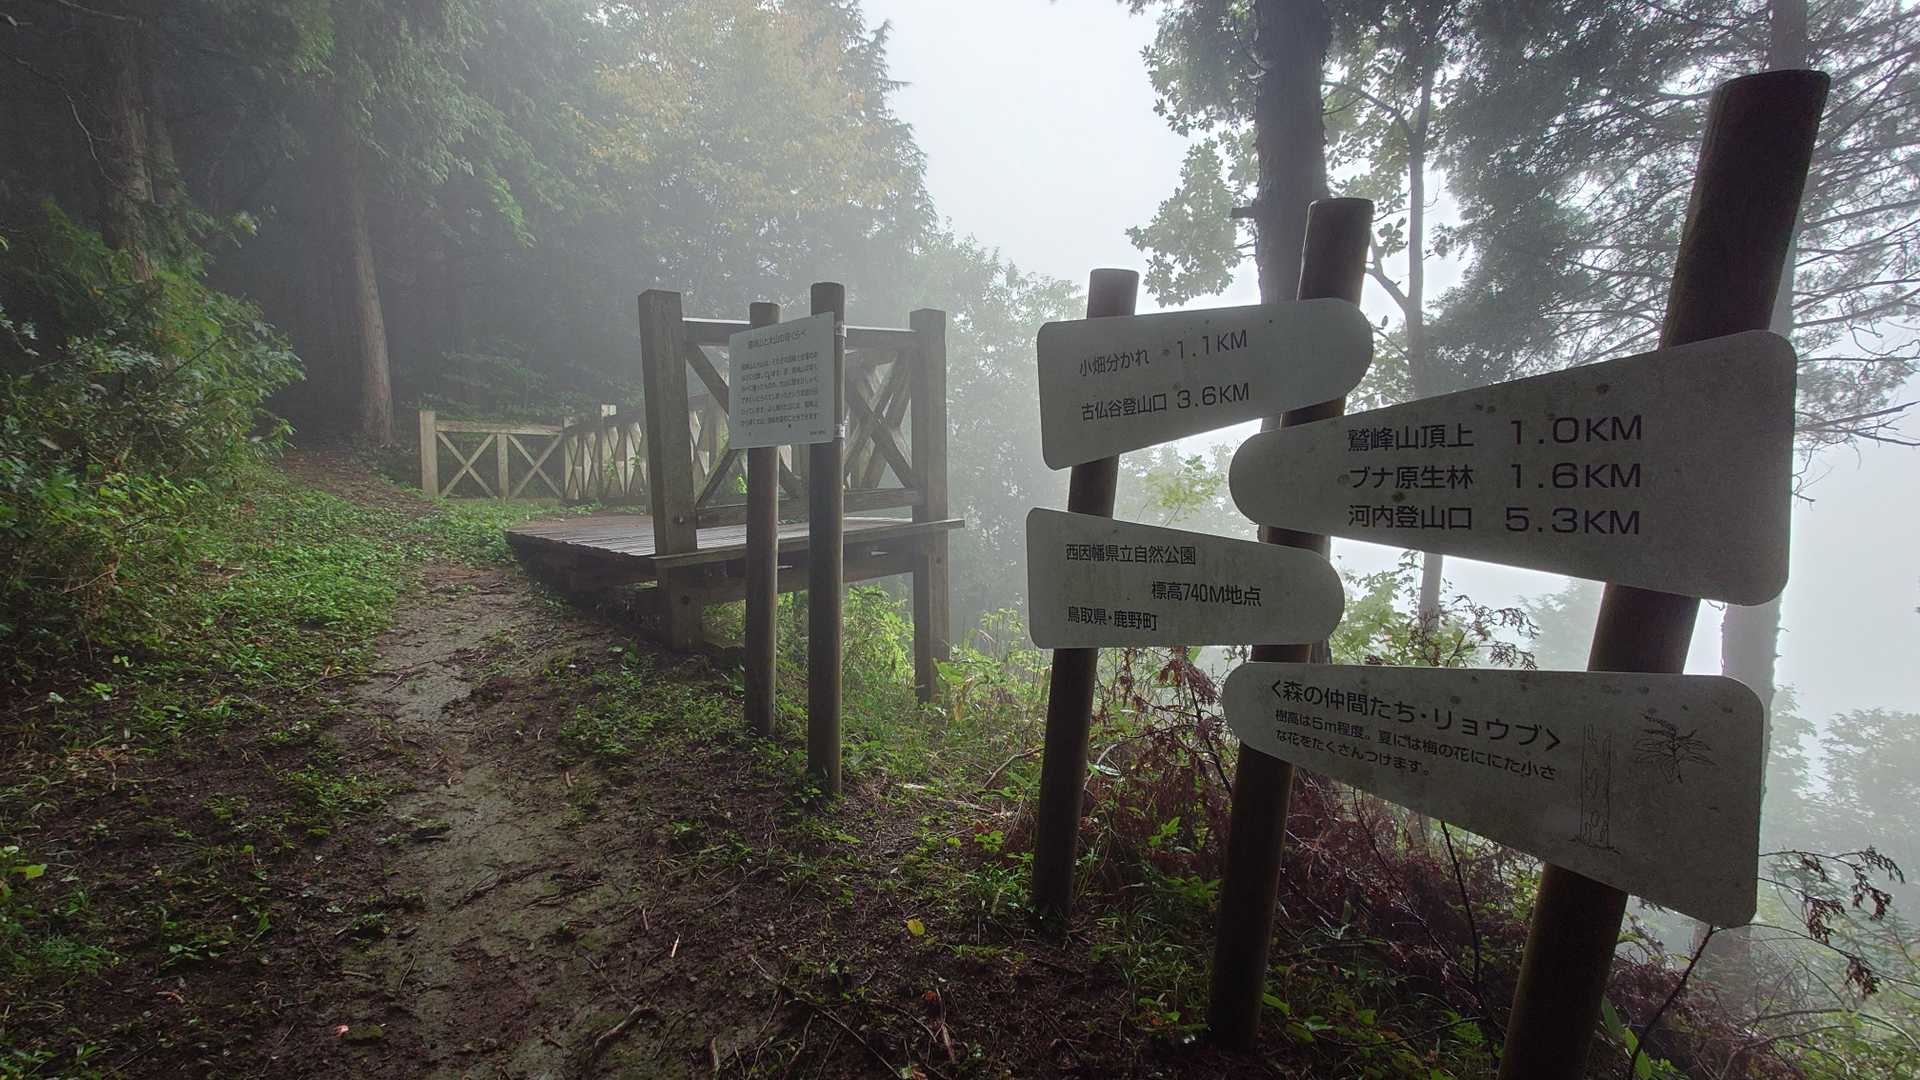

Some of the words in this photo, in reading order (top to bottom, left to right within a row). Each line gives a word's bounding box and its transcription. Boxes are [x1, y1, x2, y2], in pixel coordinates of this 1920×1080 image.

[1177, 329, 1248, 360] 1.1KM
[1081, 393, 1168, 422] 古仏谷登山口
[1176, 382, 1250, 410] 3.6KM
[1348, 423, 1474, 451] 鷲峰山頂上
[1510, 414, 1642, 445] 1.0KM
[1350, 465, 1474, 489] ブナ原生林
[1511, 463, 1642, 489] 1.6KM
[1348, 504, 1472, 530] 河内登山口
[1505, 507, 1640, 535] 5.3KM
[1066, 544, 1196, 565] 西因幡県立自然公園
[1152, 581, 1262, 607] 標高740M地点
[1067, 606, 1158, 631] 鳥取県・鹿野町
[1275, 728, 1431, 776] な花をたくさんつけます。
